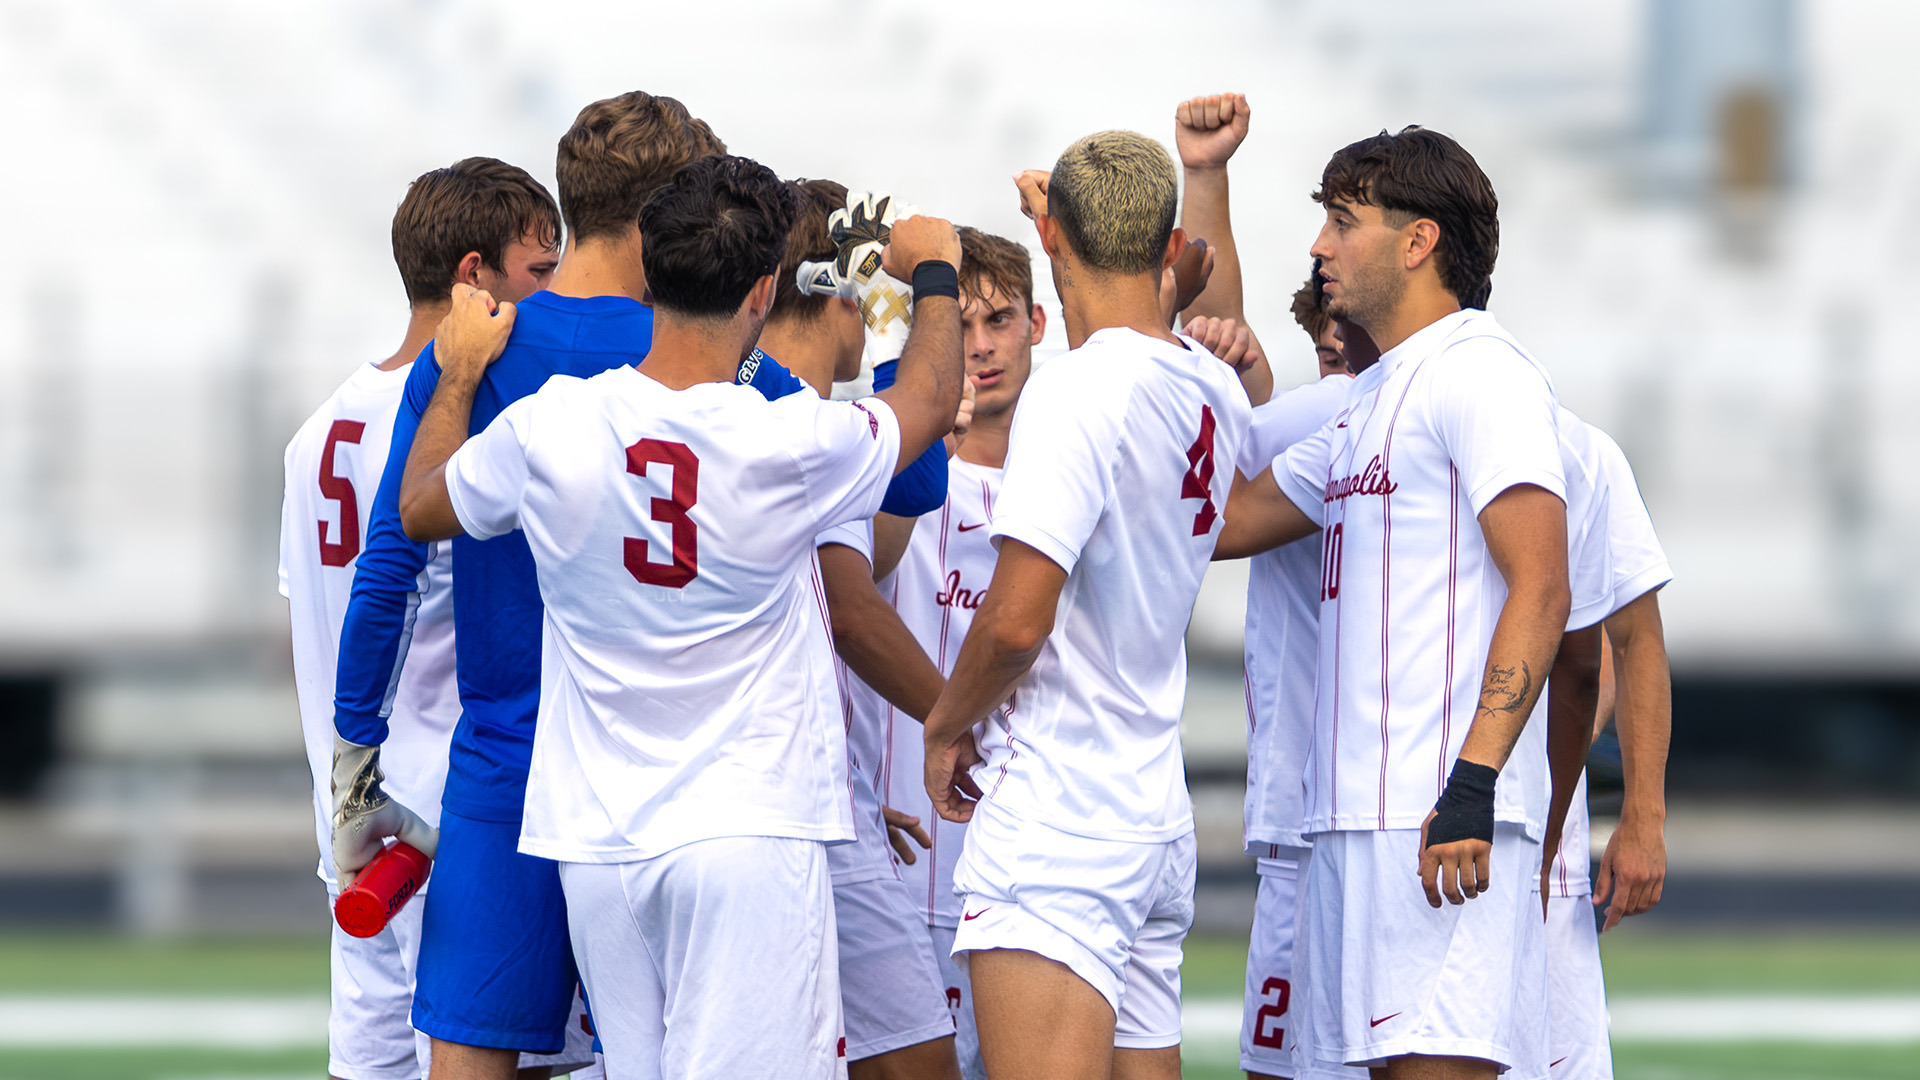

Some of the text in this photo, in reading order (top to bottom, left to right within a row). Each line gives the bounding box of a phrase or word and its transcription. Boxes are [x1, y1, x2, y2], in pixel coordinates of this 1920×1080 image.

[318, 419, 367, 567] 5
[623, 437, 700, 589] 3
[1181, 404, 1218, 537] 4
[1320, 522, 1343, 602] 10
[388, 877, 415, 909] FORZA
[1253, 976, 1291, 1049] 2
